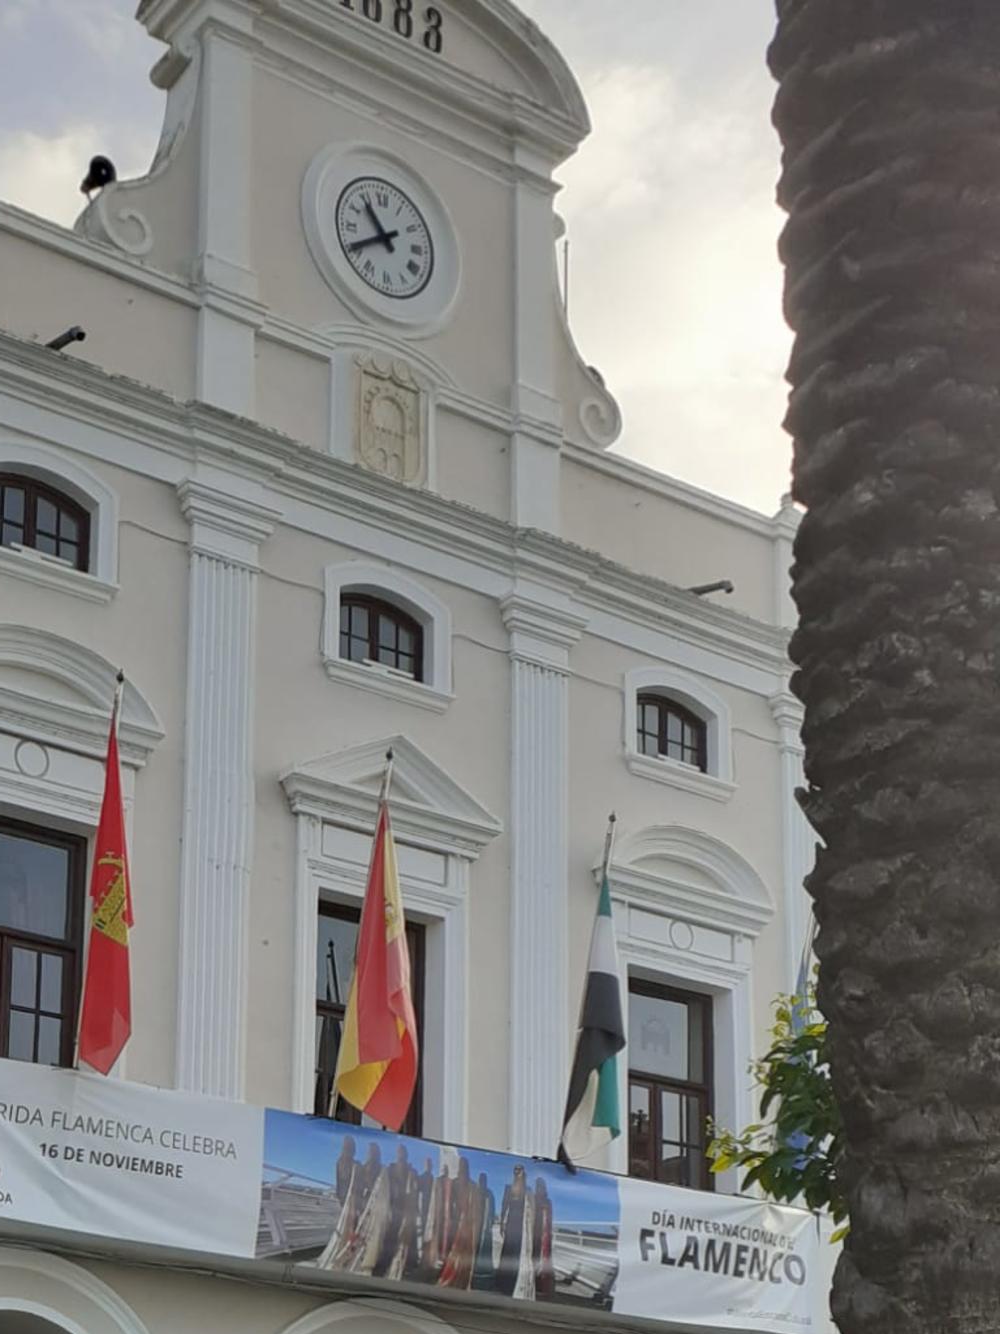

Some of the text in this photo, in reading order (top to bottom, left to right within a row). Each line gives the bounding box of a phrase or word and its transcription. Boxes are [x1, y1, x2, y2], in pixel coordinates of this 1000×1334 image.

[51, 1110, 154, 1145] FLAMENCA
[160, 1129, 237, 1159] CELEBRA
[39, 1142, 184, 1179] 16 DE NOVIEMBRE
[652, 1209, 676, 1230] DÍA
[679, 1216, 778, 1248] INTERNACIONAL
[639, 1228, 806, 1286] FLAMENCO
